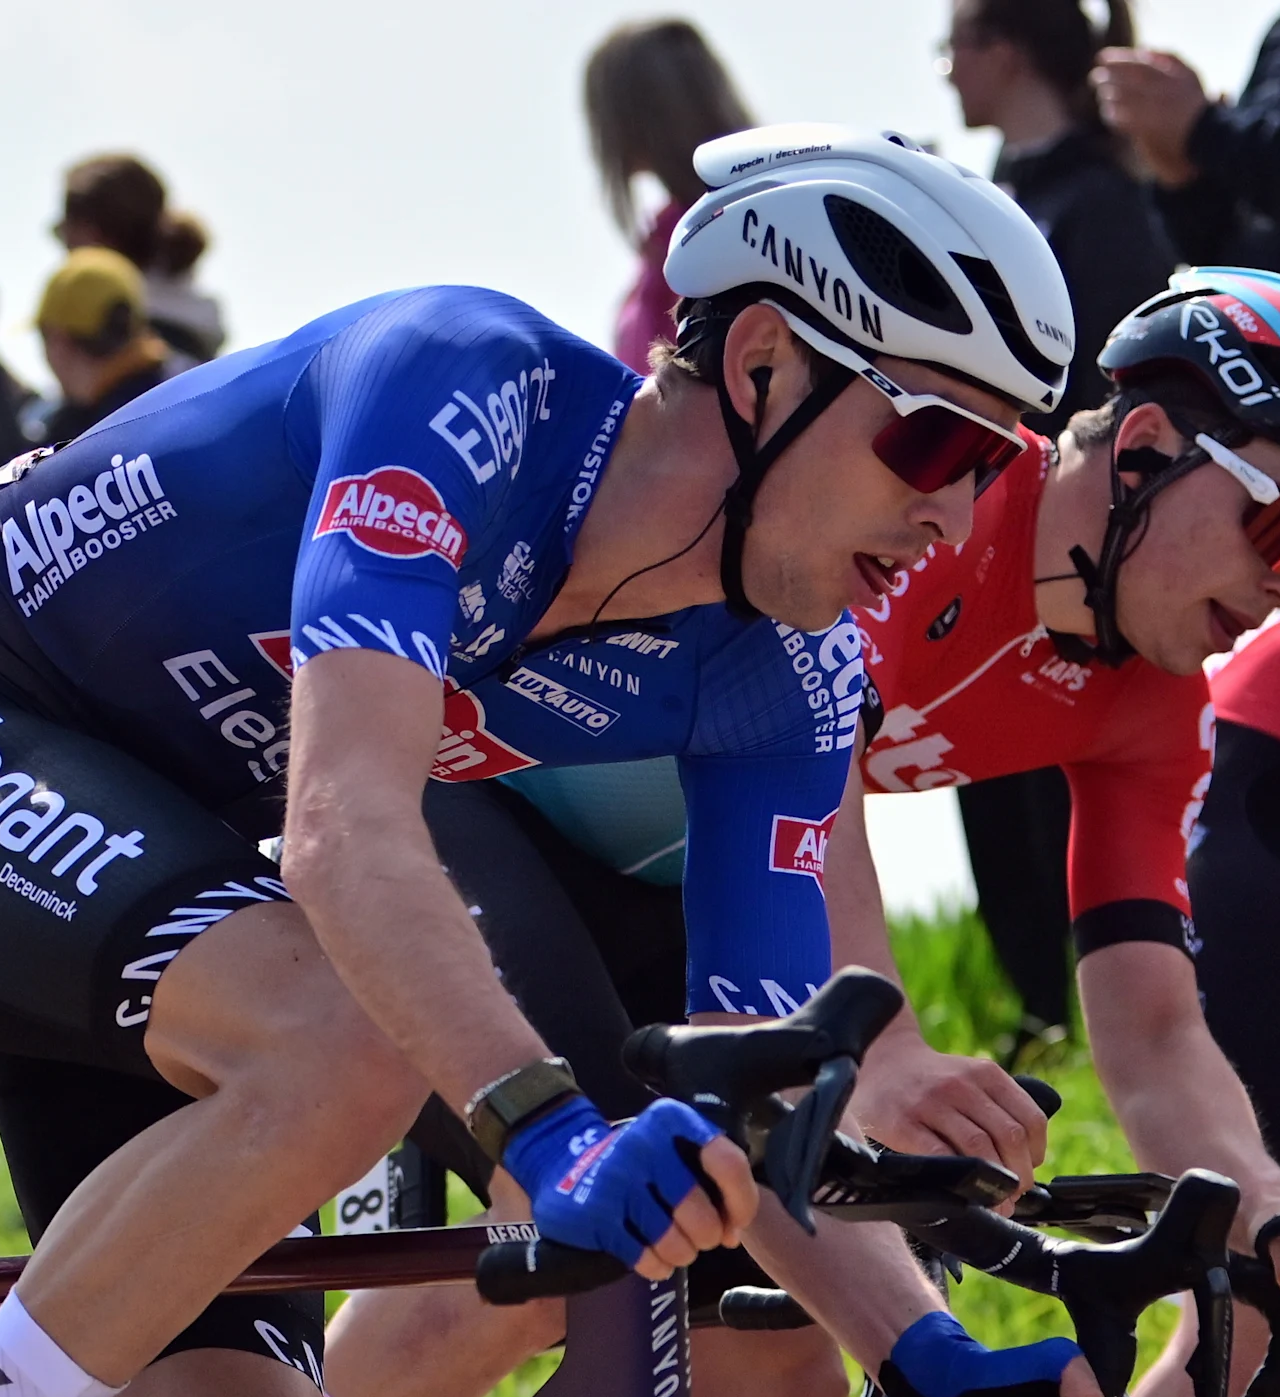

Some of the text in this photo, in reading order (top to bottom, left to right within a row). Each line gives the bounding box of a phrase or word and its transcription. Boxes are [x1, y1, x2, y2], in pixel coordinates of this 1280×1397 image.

[730, 155, 765, 175] Alpecin
[742, 208, 885, 344] CANYON
[2, 452, 166, 597] Alpecin
[17, 500, 179, 618] HAIR BOOSTER
[332, 483, 463, 558] Alpecin
[548, 650, 640, 696] CANYON
[605, 632, 680, 659] ZWIFT
[782, 633, 835, 754] BOOSTER
